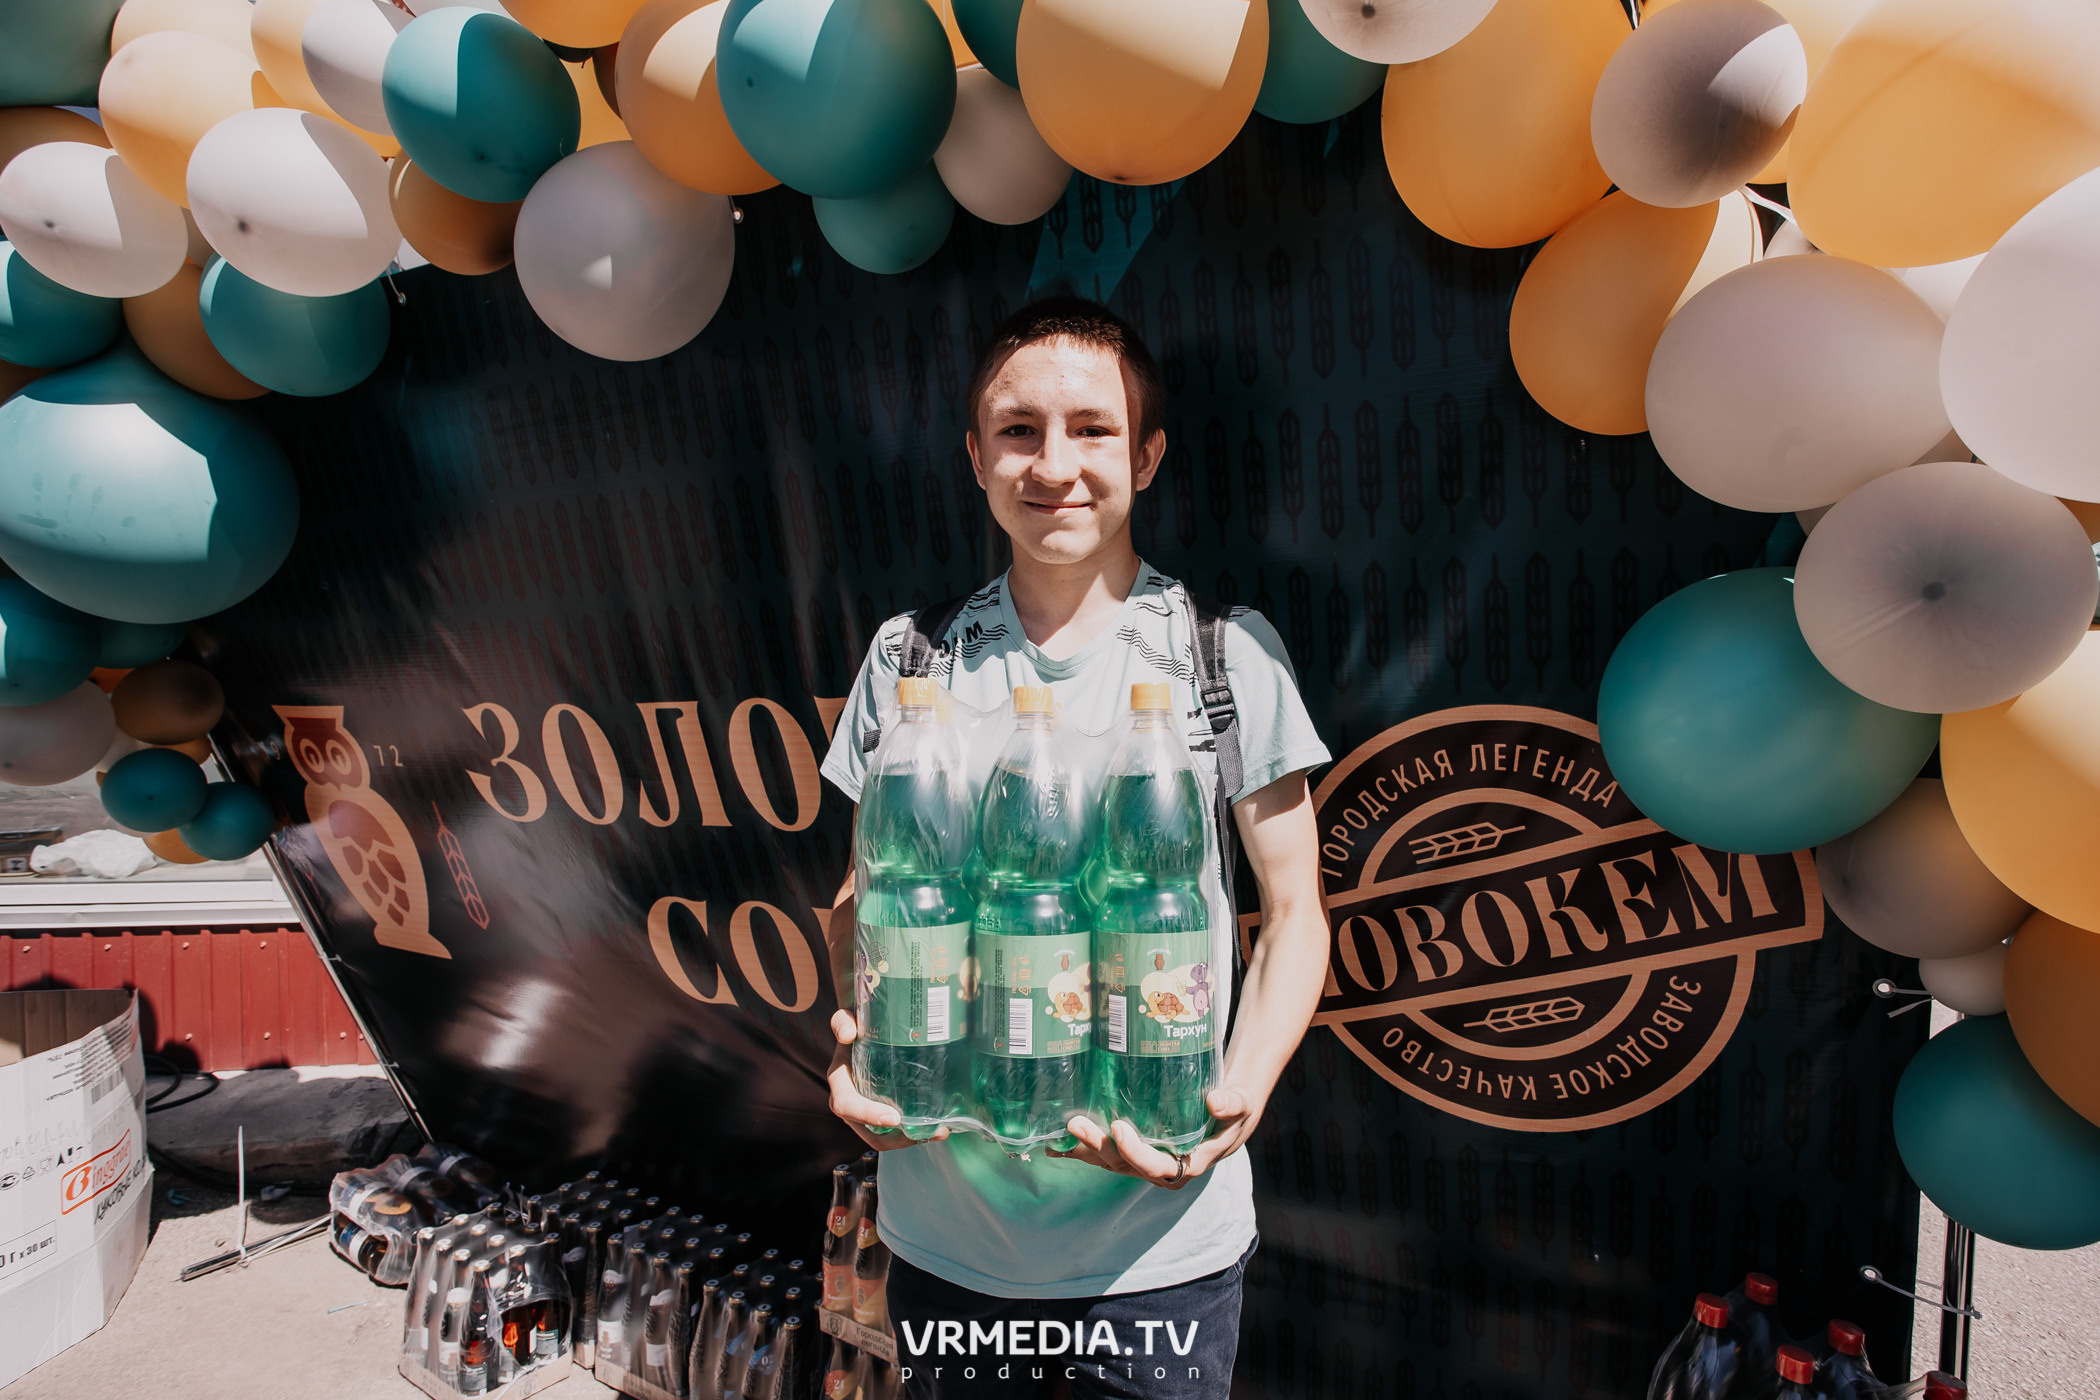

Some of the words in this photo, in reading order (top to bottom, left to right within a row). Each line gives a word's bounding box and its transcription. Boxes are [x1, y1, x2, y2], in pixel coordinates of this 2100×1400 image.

[372, 743, 405, 768] 72
[462, 696, 849, 832] ЗОЛО
[1320, 749, 1455, 878] ГОРОДСКАЯ
[1470, 743, 1618, 809] ЛЕГЕНДА
[647, 895, 835, 1013] СО
[1163, 1023, 1208, 1040] Тархун
[1383, 1026, 1538, 1101] КАЧЕСТВО
[1556, 975, 1702, 1100] ЗАВОДСКОЕ
